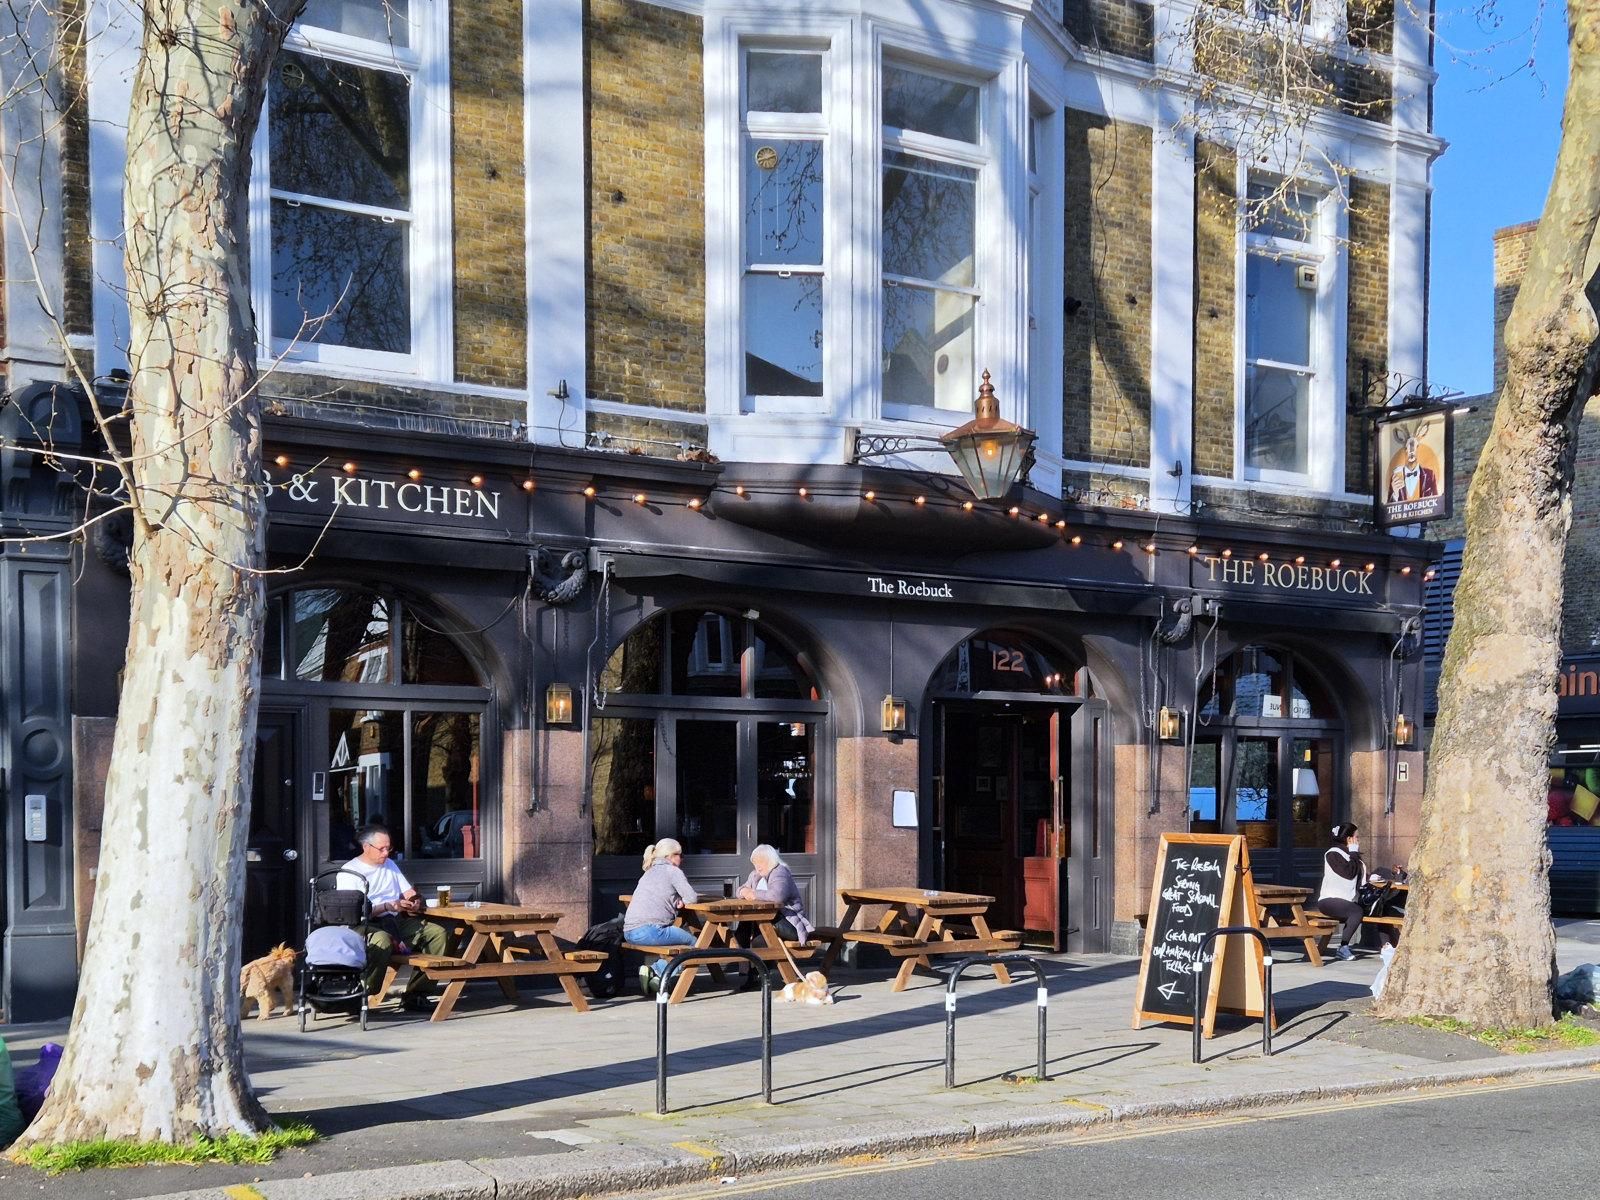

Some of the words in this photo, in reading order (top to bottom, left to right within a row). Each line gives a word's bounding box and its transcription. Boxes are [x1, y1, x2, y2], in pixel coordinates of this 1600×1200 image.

[288, 473, 319, 503] &
[331, 475, 501, 520] KITCHEN
[1387, 505, 1402, 513] THE
[1403, 499, 1437, 511] ROEBUCK
[1391, 512, 1402, 520] PUB
[1204, 556, 1255, 585] THE
[1262, 562, 1374, 595] ROEBUCK
[867, 577, 895, 594] The
[897, 579, 954, 598] Roebuck
[992, 649, 1025, 673] 122
[1558, 664, 1600, 697] ain
[1172, 903, 1193, 916] FOOD
